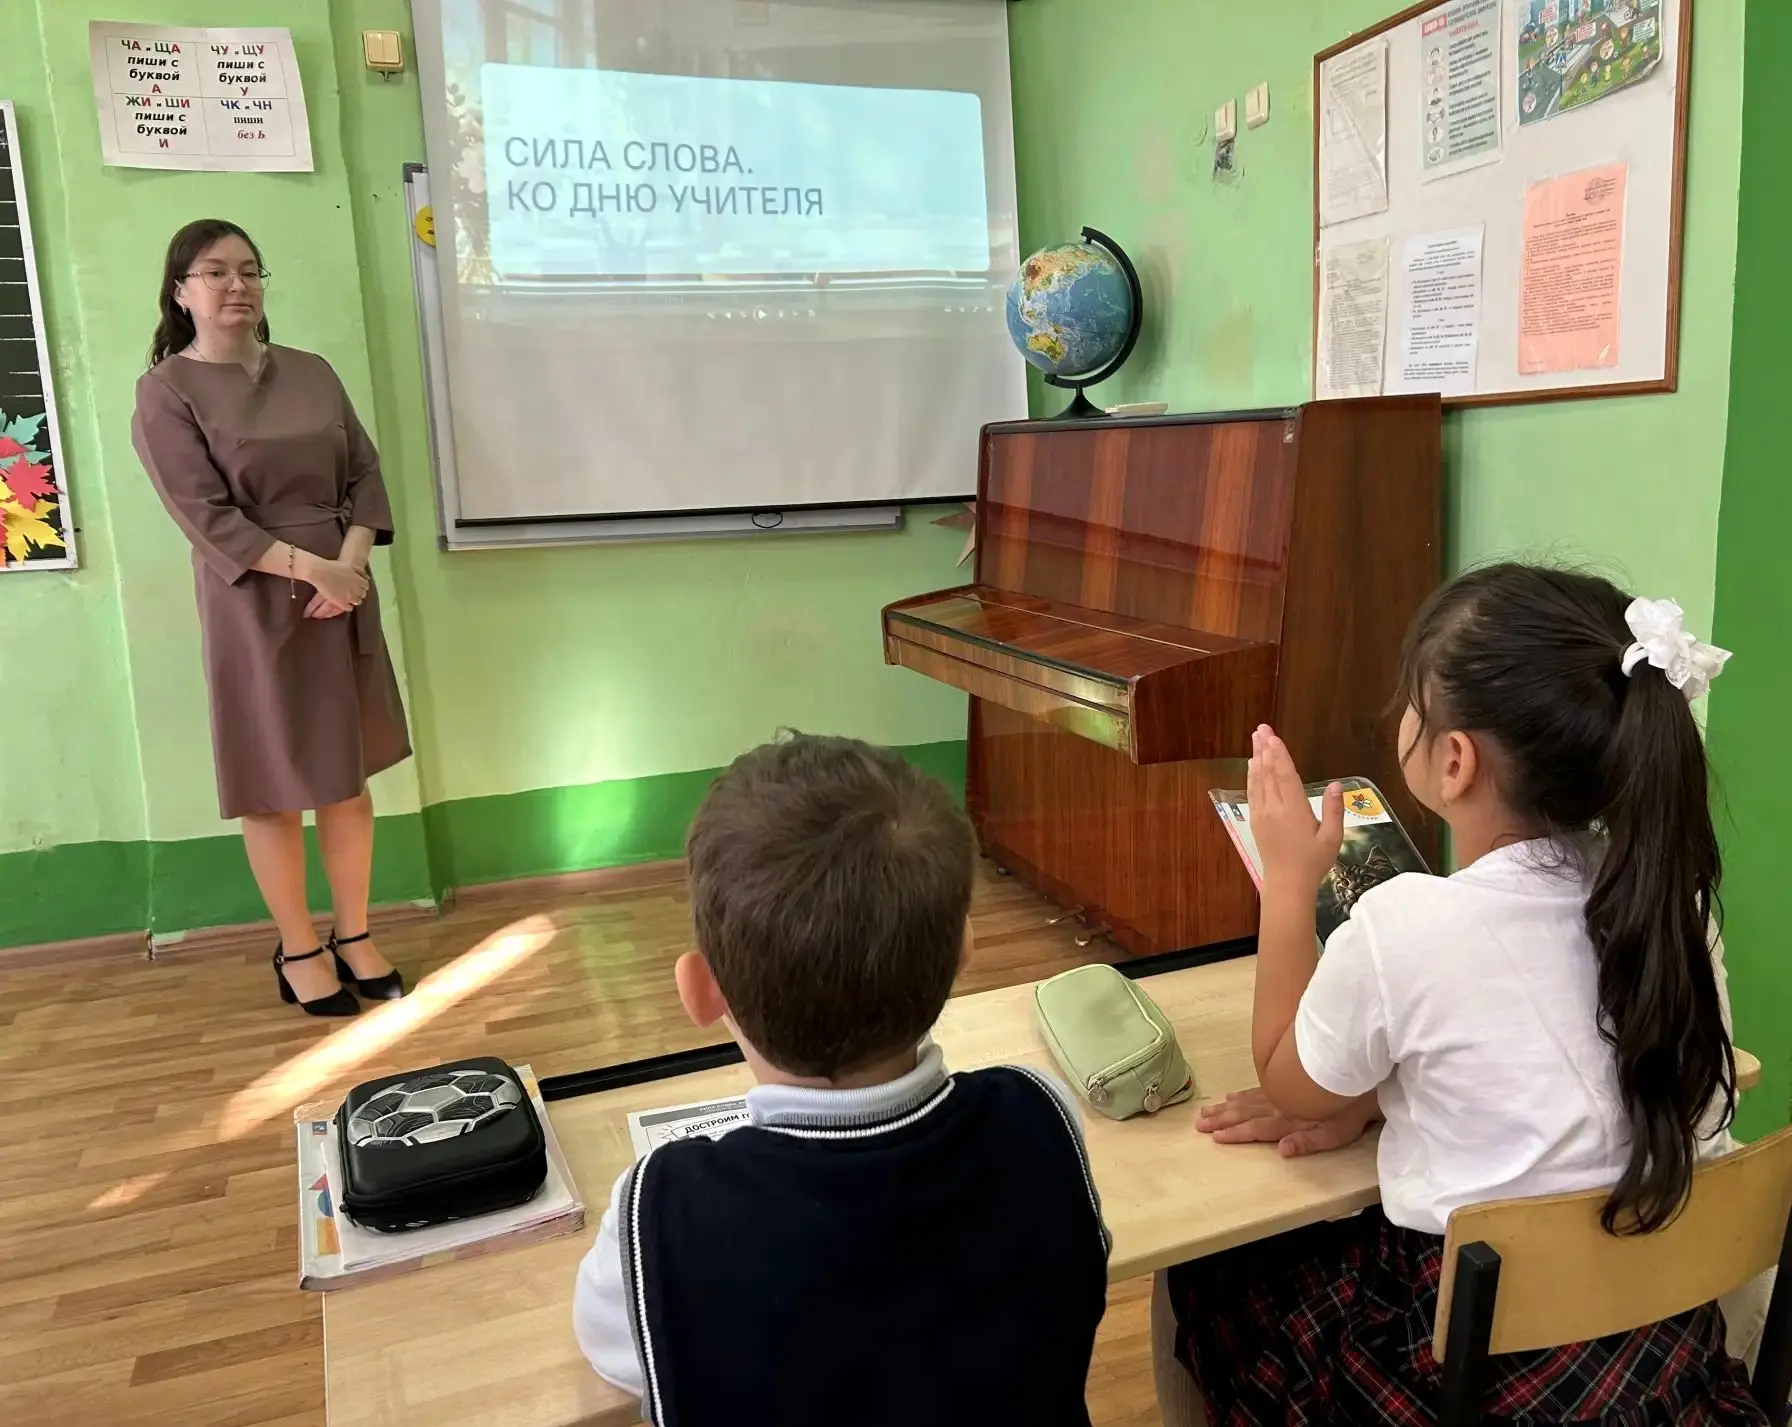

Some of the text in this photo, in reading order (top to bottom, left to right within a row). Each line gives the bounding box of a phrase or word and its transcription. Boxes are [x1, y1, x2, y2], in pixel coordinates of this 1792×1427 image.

[121, 39, 141, 51] ЧА
[154, 43, 181, 55] ЩА
[210, 45, 229, 55] ЧУ
[242, 45, 265, 56] ЩУ
[127, 56, 179, 68] пиши с
[217, 60, 254, 70] пиши
[129, 69, 180, 82] буквой
[219, 73, 266, 84] буквой
[151, 84, 162, 94] А
[240, 87, 249, 97] У
[126, 96, 151, 107] ЖИ
[165, 97, 191, 109] ШИ
[220, 100, 241, 110] ЧК
[253, 101, 273, 111] ЧН
[135, 111, 187, 122] пиши с
[137, 124, 187, 136] буквой
[237, 129, 255, 140] без
[158, 138, 170, 149] И
[504, 136, 755, 175] СИЛА СЛОВА.
[507, 181, 824, 218] КО ДНЮ УЧИТЕЛЯ
[685, 1115, 740, 1134] ДОСТРОИМ
